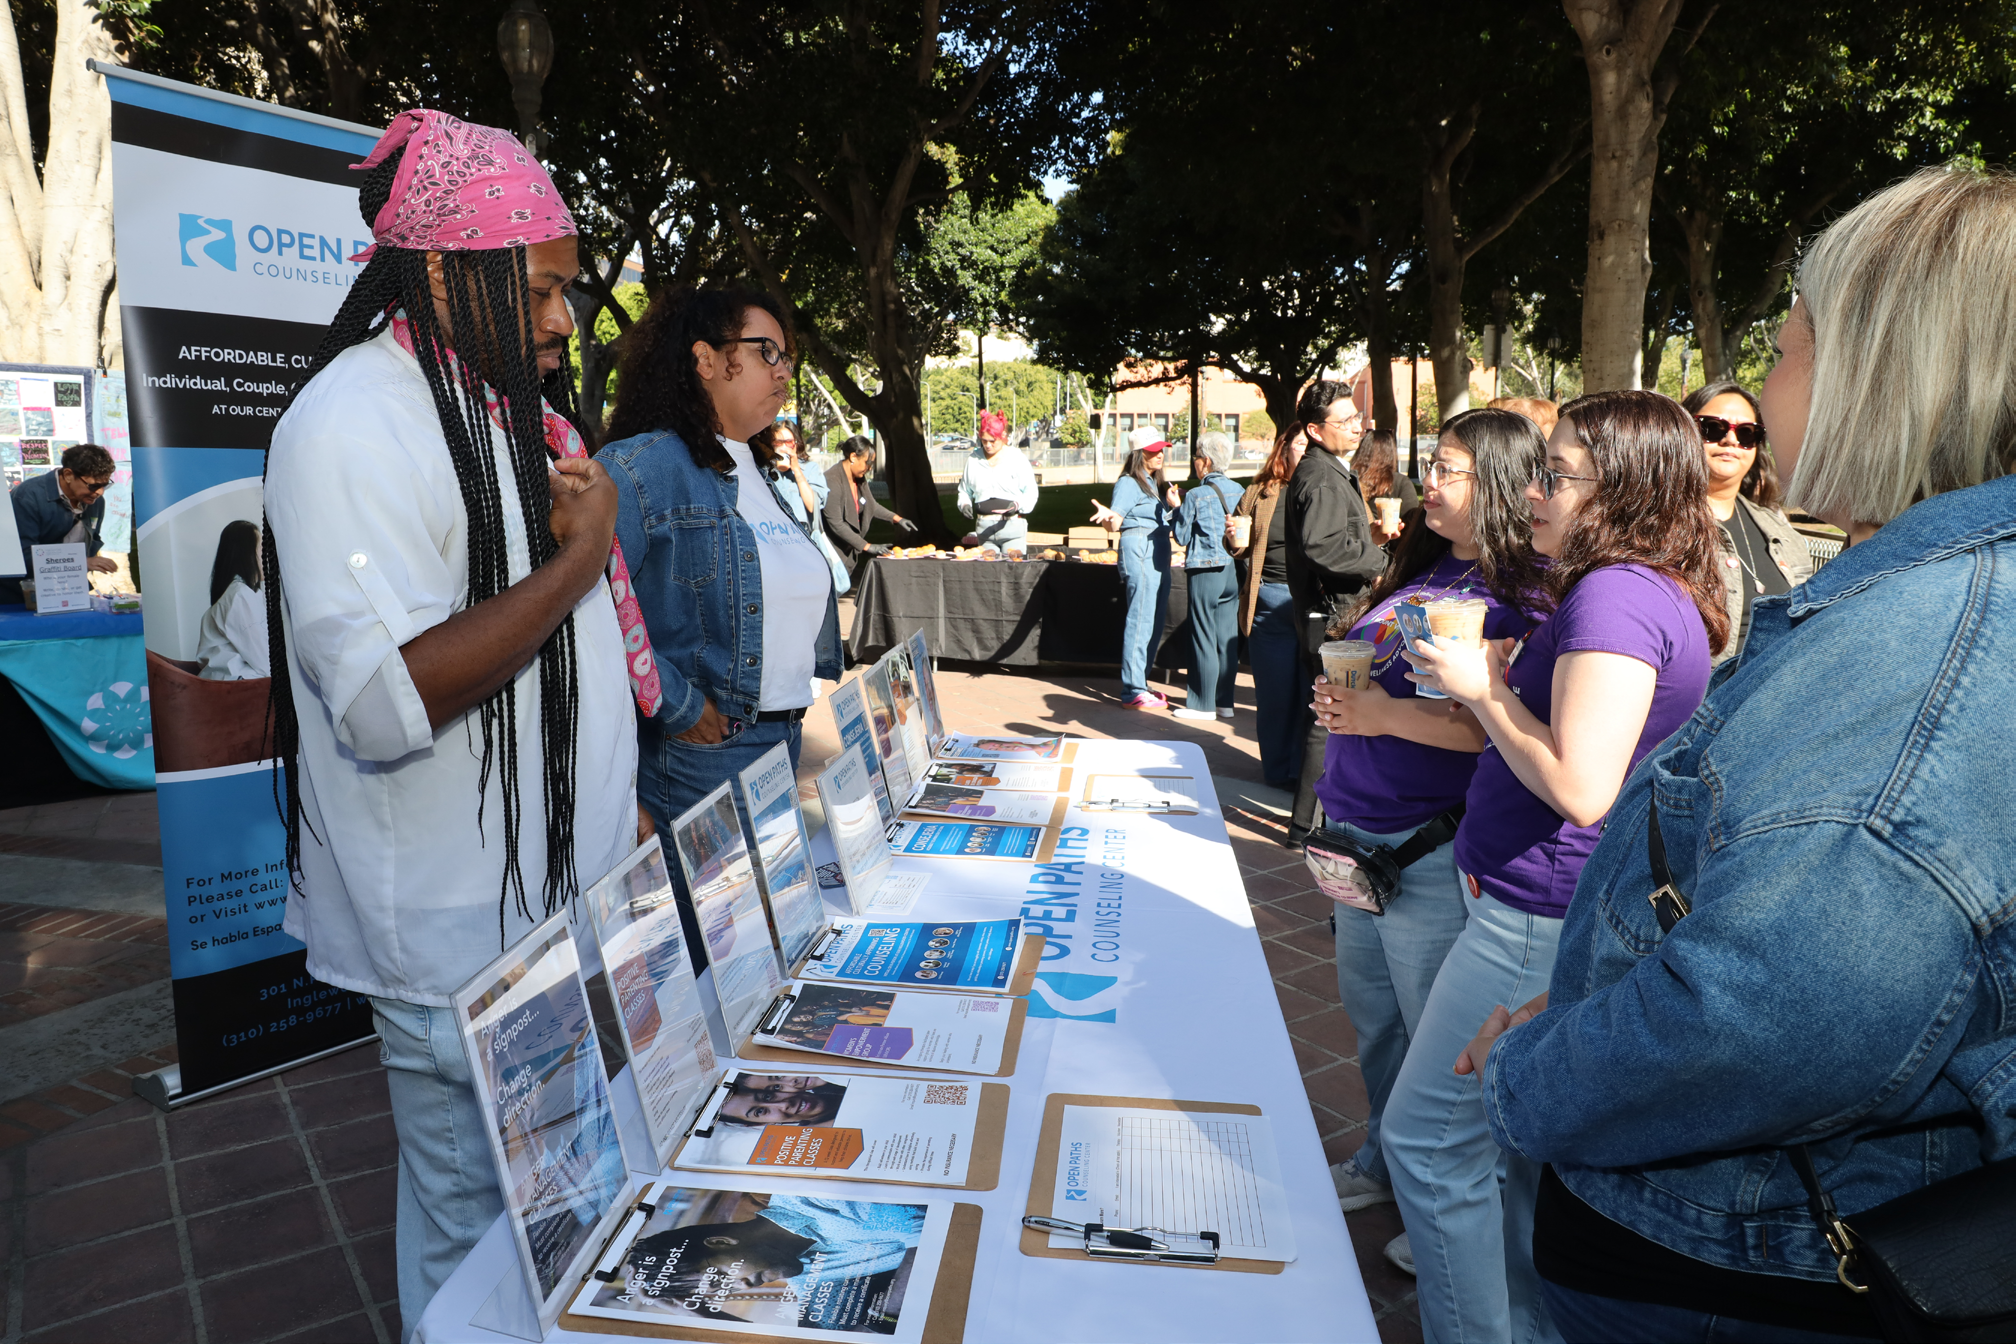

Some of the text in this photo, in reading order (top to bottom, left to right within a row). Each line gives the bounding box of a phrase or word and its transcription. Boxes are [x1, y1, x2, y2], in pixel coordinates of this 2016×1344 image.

[248, 225, 342, 264] OPEN
[178, 346, 288, 368] AFFORDABLE,
[142, 373, 288, 396] Individual, Couple,
[212, 405, 282, 417] AT OUR CENT
[186, 859, 289, 889] For More Inf
[187, 878, 284, 906] Please Call:
[188, 913, 206, 925] or
[212, 902, 249, 920] Visit
[1091, 828, 1126, 962] COUNSELING CENTER
[190, 922, 282, 951] Se habla Espa
[1020, 890, 1080, 961] OPEN
[862, 927, 902, 975] COUNSELING
[259, 983, 287, 1001] 301
[616, 961, 639, 993] POSITIVE
[620, 968, 649, 1007] PARENTING
[481, 996, 517, 1039] Anger is
[623, 988, 646, 1020] CLASSES
[222, 1002, 341, 1046] (310) 258-9677
[485, 1008, 539, 1062] a signpost...
[496, 1063, 531, 1105] Change
[502, 1079, 544, 1129] direction.
[773, 1135, 796, 1163] POSITIVE
[788, 1127, 814, 1164] PARENTING
[802, 1138, 823, 1165] CLASSES
[1066, 1141, 1082, 1186] OPEN PATHS
[523, 1139, 573, 1210] MANAGEMENT
[1081, 1159, 1089, 1186] COUNSELING
[527, 1180, 558, 1226] CLASSES
[616, 1255, 657, 1303] Anger is
[647, 1239, 689, 1295] signpost...
[701, 1258, 745, 1312] direction.
[791, 1251, 828, 1320] MANAGEMENT
[681, 1266, 718, 1310] Change
[773, 1283, 799, 1318] ANGER
[807, 1280, 834, 1321] CLASSES
[842, 1290, 857, 1311] complete
[852, 1302, 863, 1319] receive
[858, 1276, 871, 1298] certificate
[838, 1312, 849, 1324] Must
